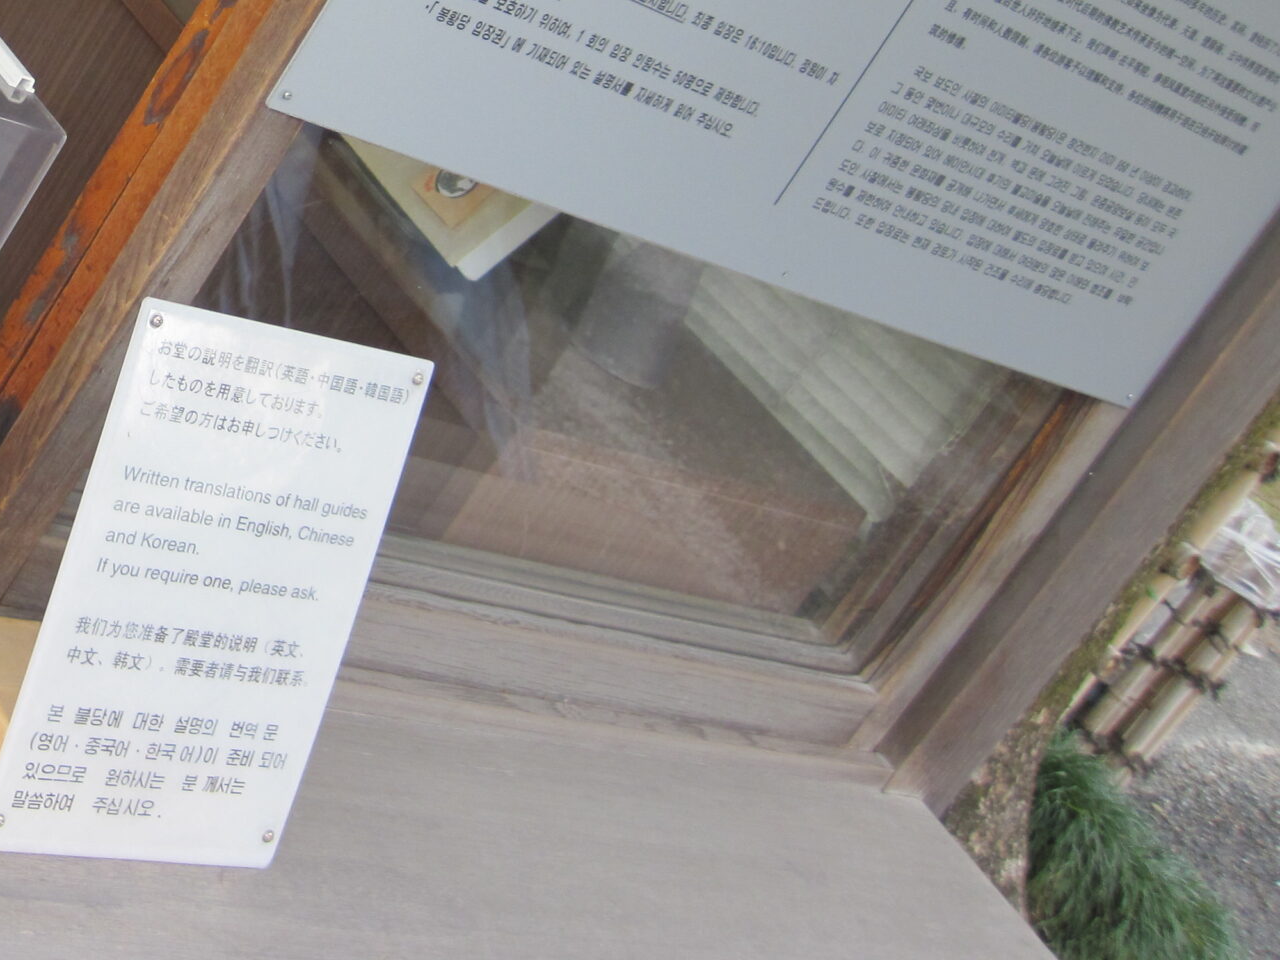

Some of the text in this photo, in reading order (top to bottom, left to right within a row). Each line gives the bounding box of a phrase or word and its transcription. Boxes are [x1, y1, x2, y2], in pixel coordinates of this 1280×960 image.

[123, 464, 368, 520] Written translations of hall guides
[104, 529, 199, 555] and Korean.
[112, 498, 354, 547] are available in English, Chinese
[95, 556, 318, 601] If you require one, please ask.
